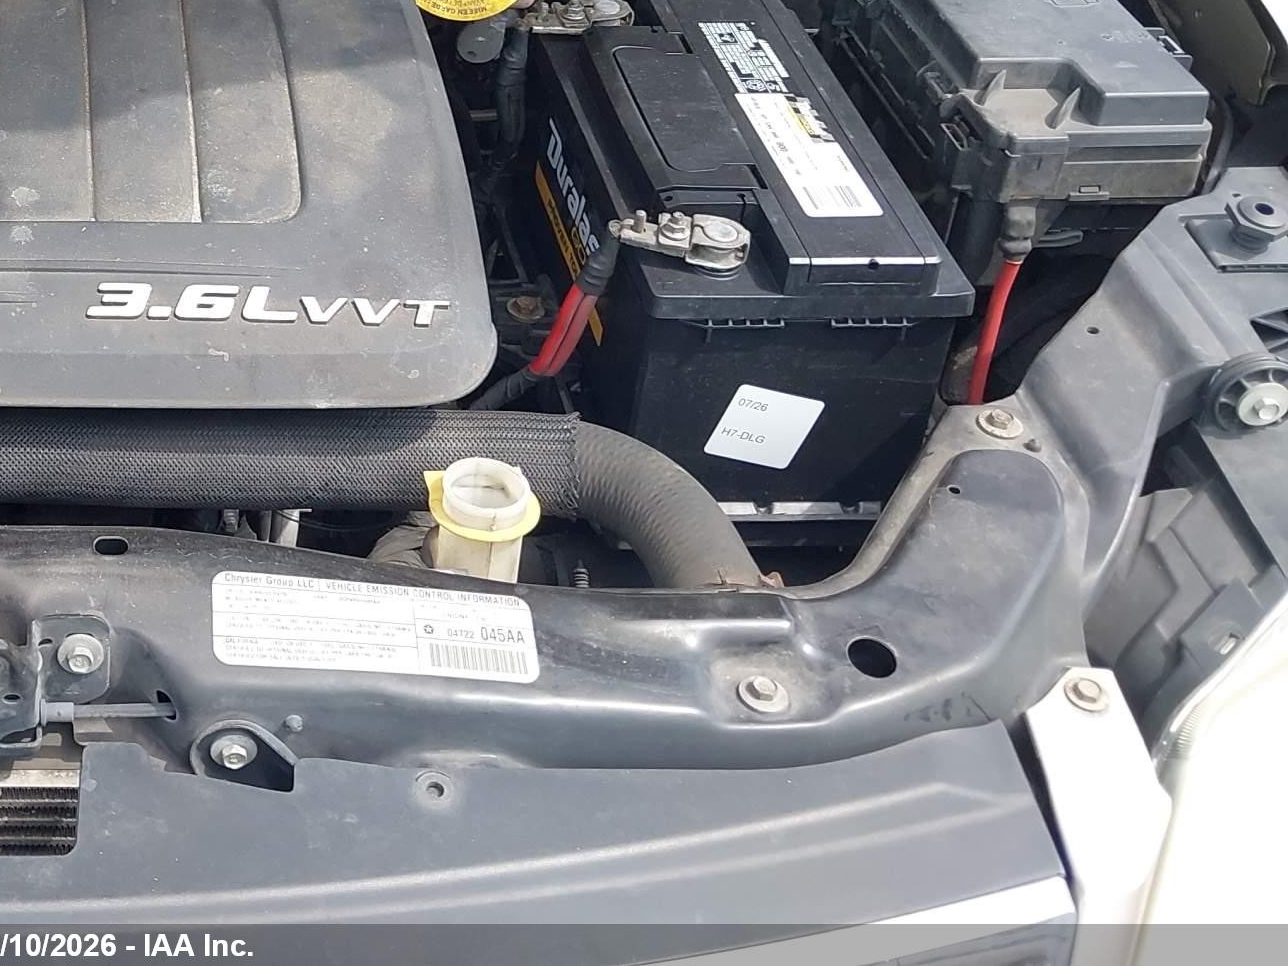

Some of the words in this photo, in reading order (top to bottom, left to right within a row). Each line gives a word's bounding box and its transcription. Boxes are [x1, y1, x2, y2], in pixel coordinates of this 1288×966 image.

[546, 116, 600, 256] Duralas
[738, 398, 769, 412] 07/26
[721, 427, 766, 444] H7-DLG
[224, 573, 262, 584] Chrysler
[266, 575, 294, 587] Group
[297, 578, 314, 588] LLC
[326, 579, 362, 592] VEHICLE
[367, 584, 410, 597] EMISSION
[414, 588, 454, 601] CONTROL
[458, 593, 520, 607] INFORMATION
[480, 626, 526, 644] 045AA
